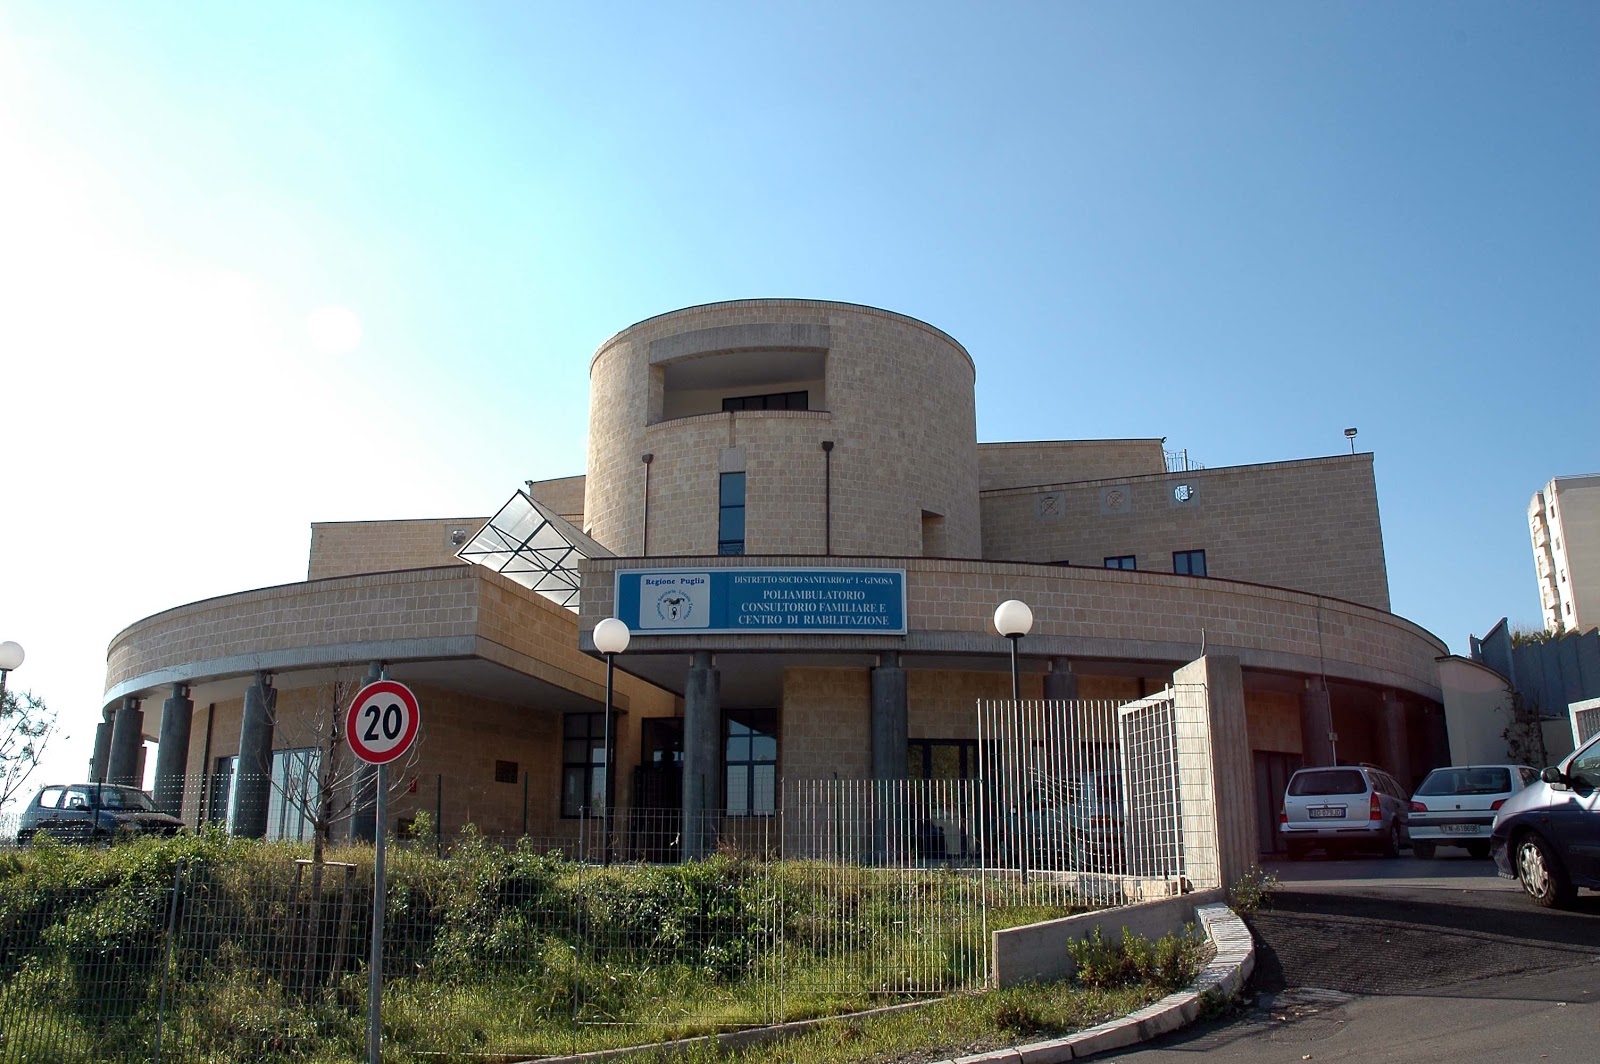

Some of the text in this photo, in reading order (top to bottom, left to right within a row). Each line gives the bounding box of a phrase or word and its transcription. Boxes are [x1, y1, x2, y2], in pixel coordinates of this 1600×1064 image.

[645, 577, 705, 586] Regione Puglia
[734, 576, 778, 584] DISTRETTO
[778, 576, 803, 584] SOCIO
[804, 576, 845, 584] SANITARIO
[864, 577, 893, 585] GINOSA
[763, 590, 866, 600] POLIAMBULATORIO
[741, 602, 886, 613] CONSULTORIO FAMILIARE E
[738, 615, 890, 625] CENTRO DI RIABILITAZIONE
[364, 703, 402, 741] 20
